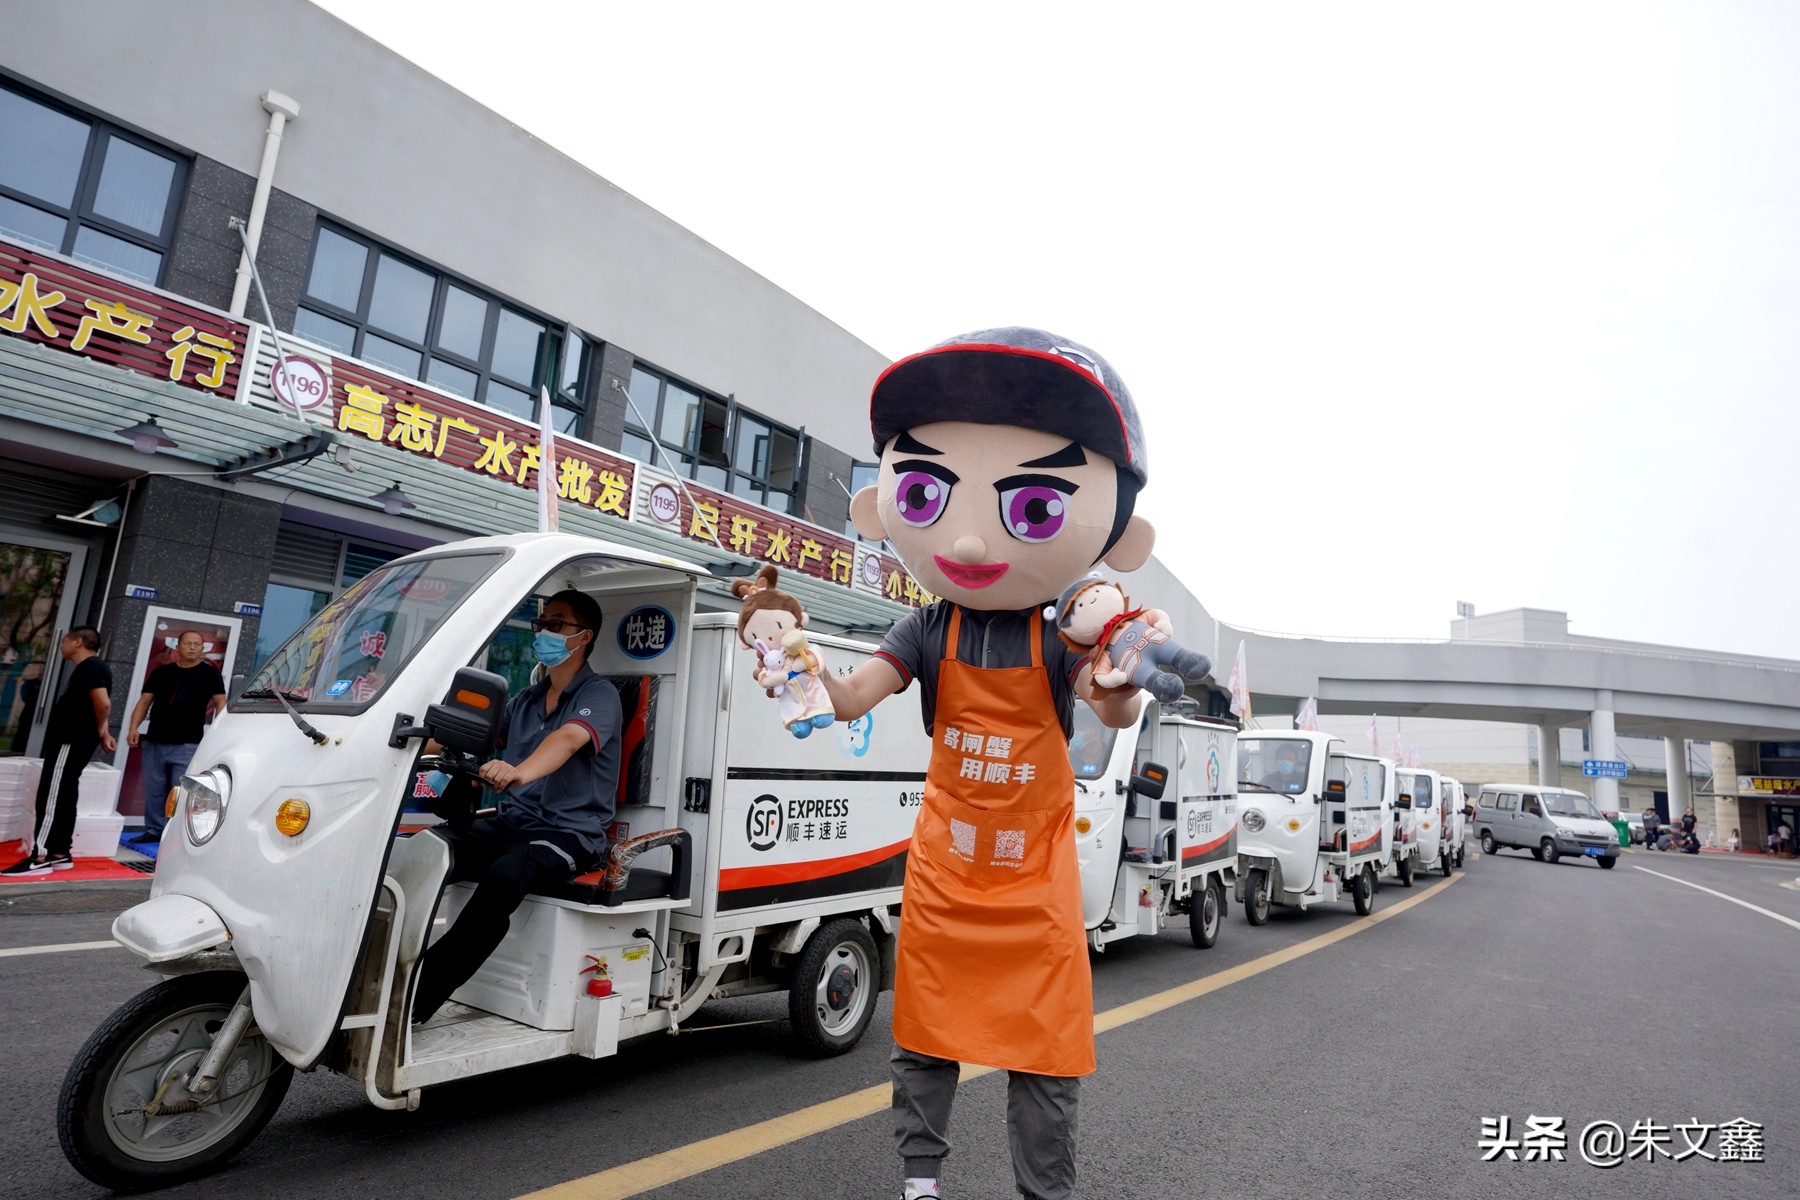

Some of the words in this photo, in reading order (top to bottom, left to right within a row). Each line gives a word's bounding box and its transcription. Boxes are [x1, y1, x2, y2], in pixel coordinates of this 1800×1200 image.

[278, 369, 322, 396] 1196
[653, 494, 677, 513] 1195
[688, 501, 854, 584] 启轩水产行
[866, 563, 880, 577] 1193
[136, 589, 156, 599] 1197
[626, 614, 666, 651] 快递
[943, 726, 1013, 759] 寄闸蟹
[959, 757, 1037, 785] 用顺丰
[787, 798, 849, 819] EXPRESS
[785, 820, 848, 842] 顺丰速运
